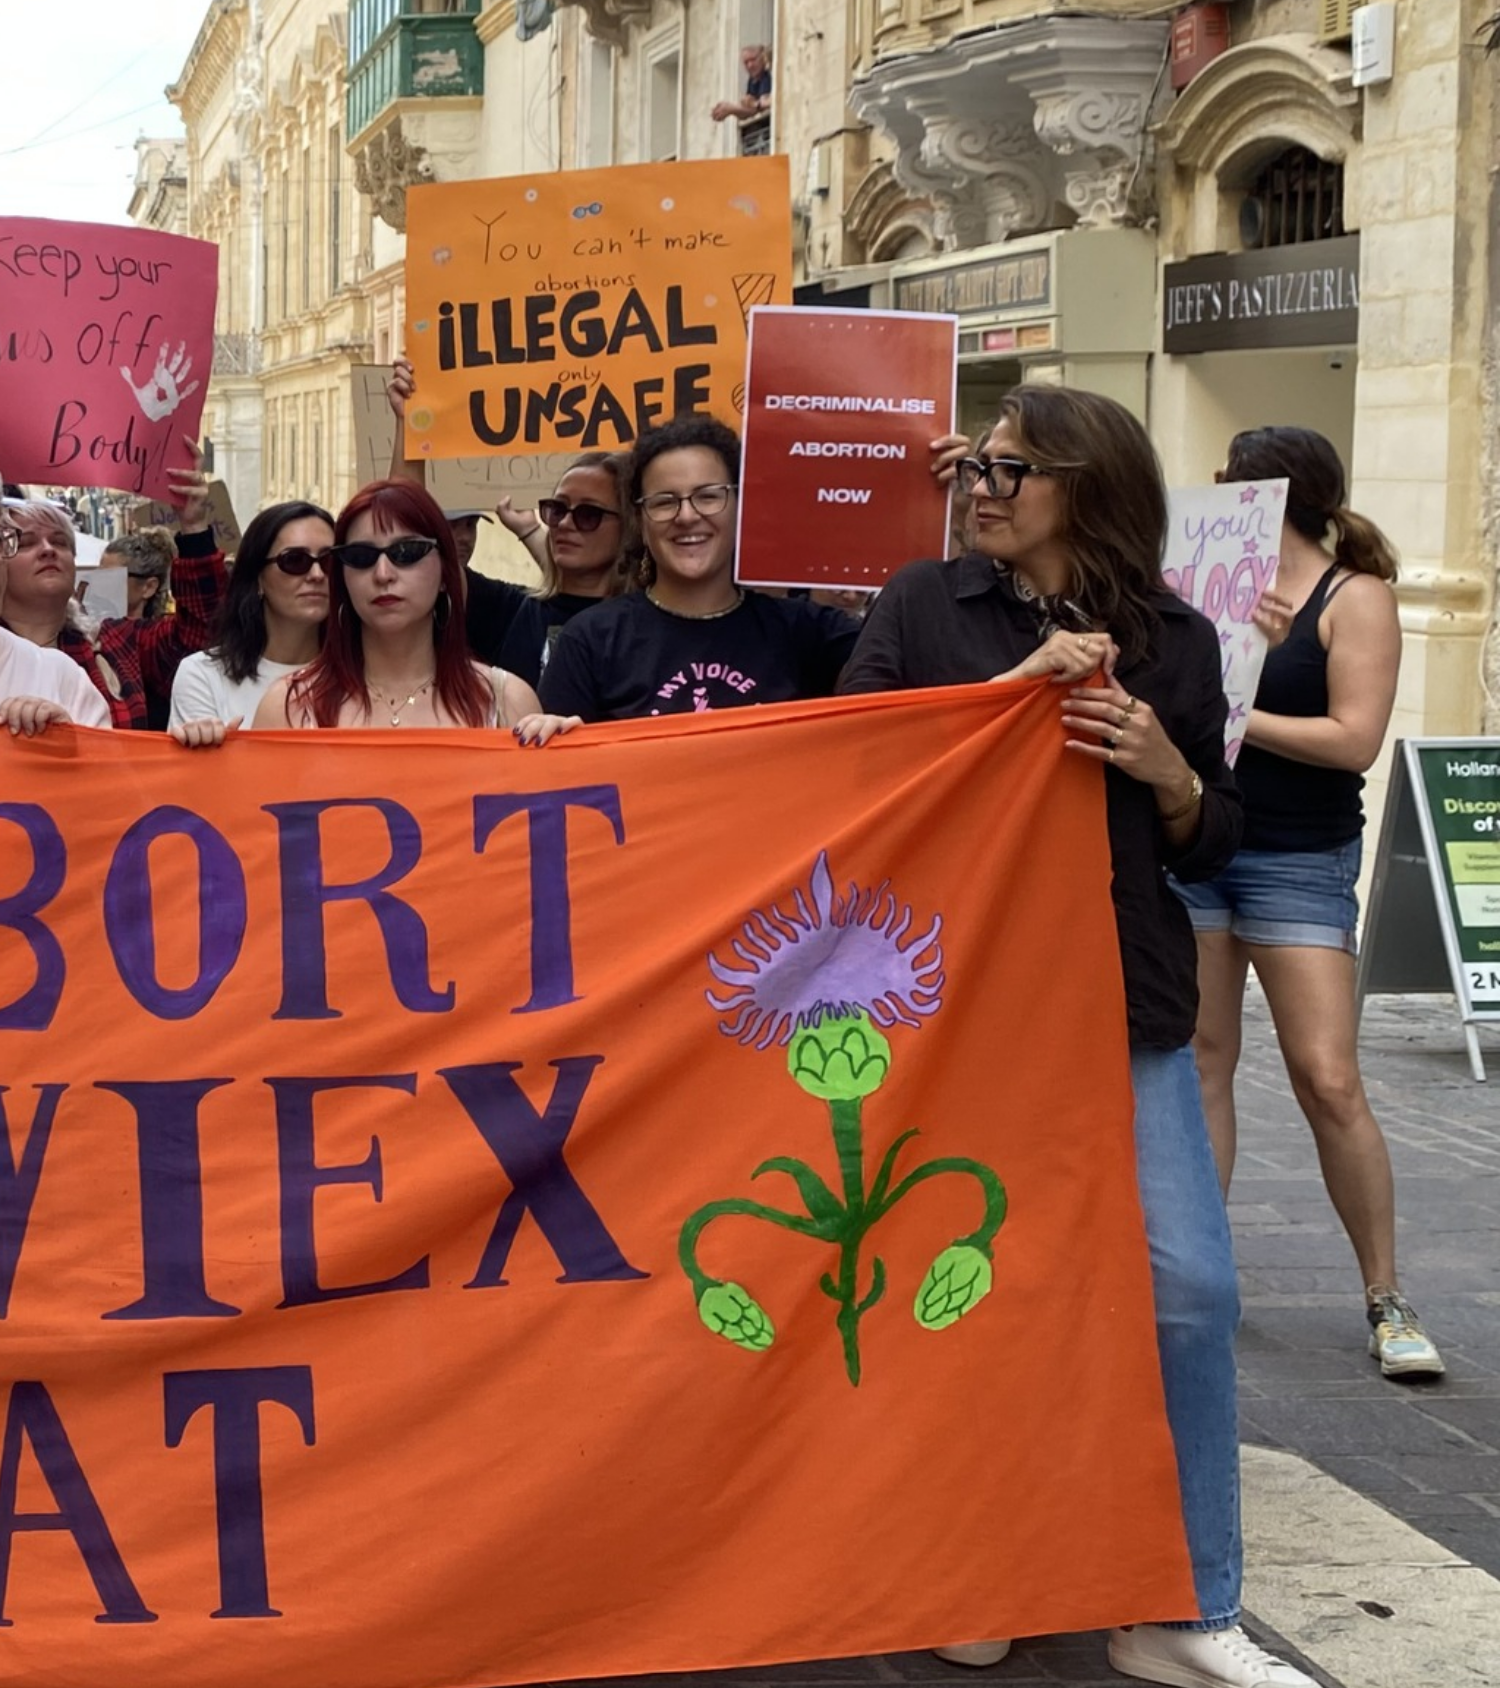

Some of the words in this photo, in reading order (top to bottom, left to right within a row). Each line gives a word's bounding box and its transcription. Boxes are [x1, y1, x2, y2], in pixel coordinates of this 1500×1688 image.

[473, 210, 543, 264] You
[572, 228, 652, 257] can't
[664, 229, 732, 252] make
[95, 252, 172, 301] your
[534, 272, 638, 293] abortions
[1167, 281, 1223, 331] JEFF'S
[1228, 266, 1361, 319] PASTIZZERIA
[557, 364, 602, 389] only
[469, 362, 712, 447] UNSAFE
[764, 394, 937, 416] DECRIMINALISE
[789, 441, 907, 460] ABORTION
[817, 488, 872, 505] NOW
[1183, 506, 1271, 570] your
[656, 670, 688, 699] MY
[690, 662, 757, 694] VOICE
[1473, 815, 1494, 832] of
